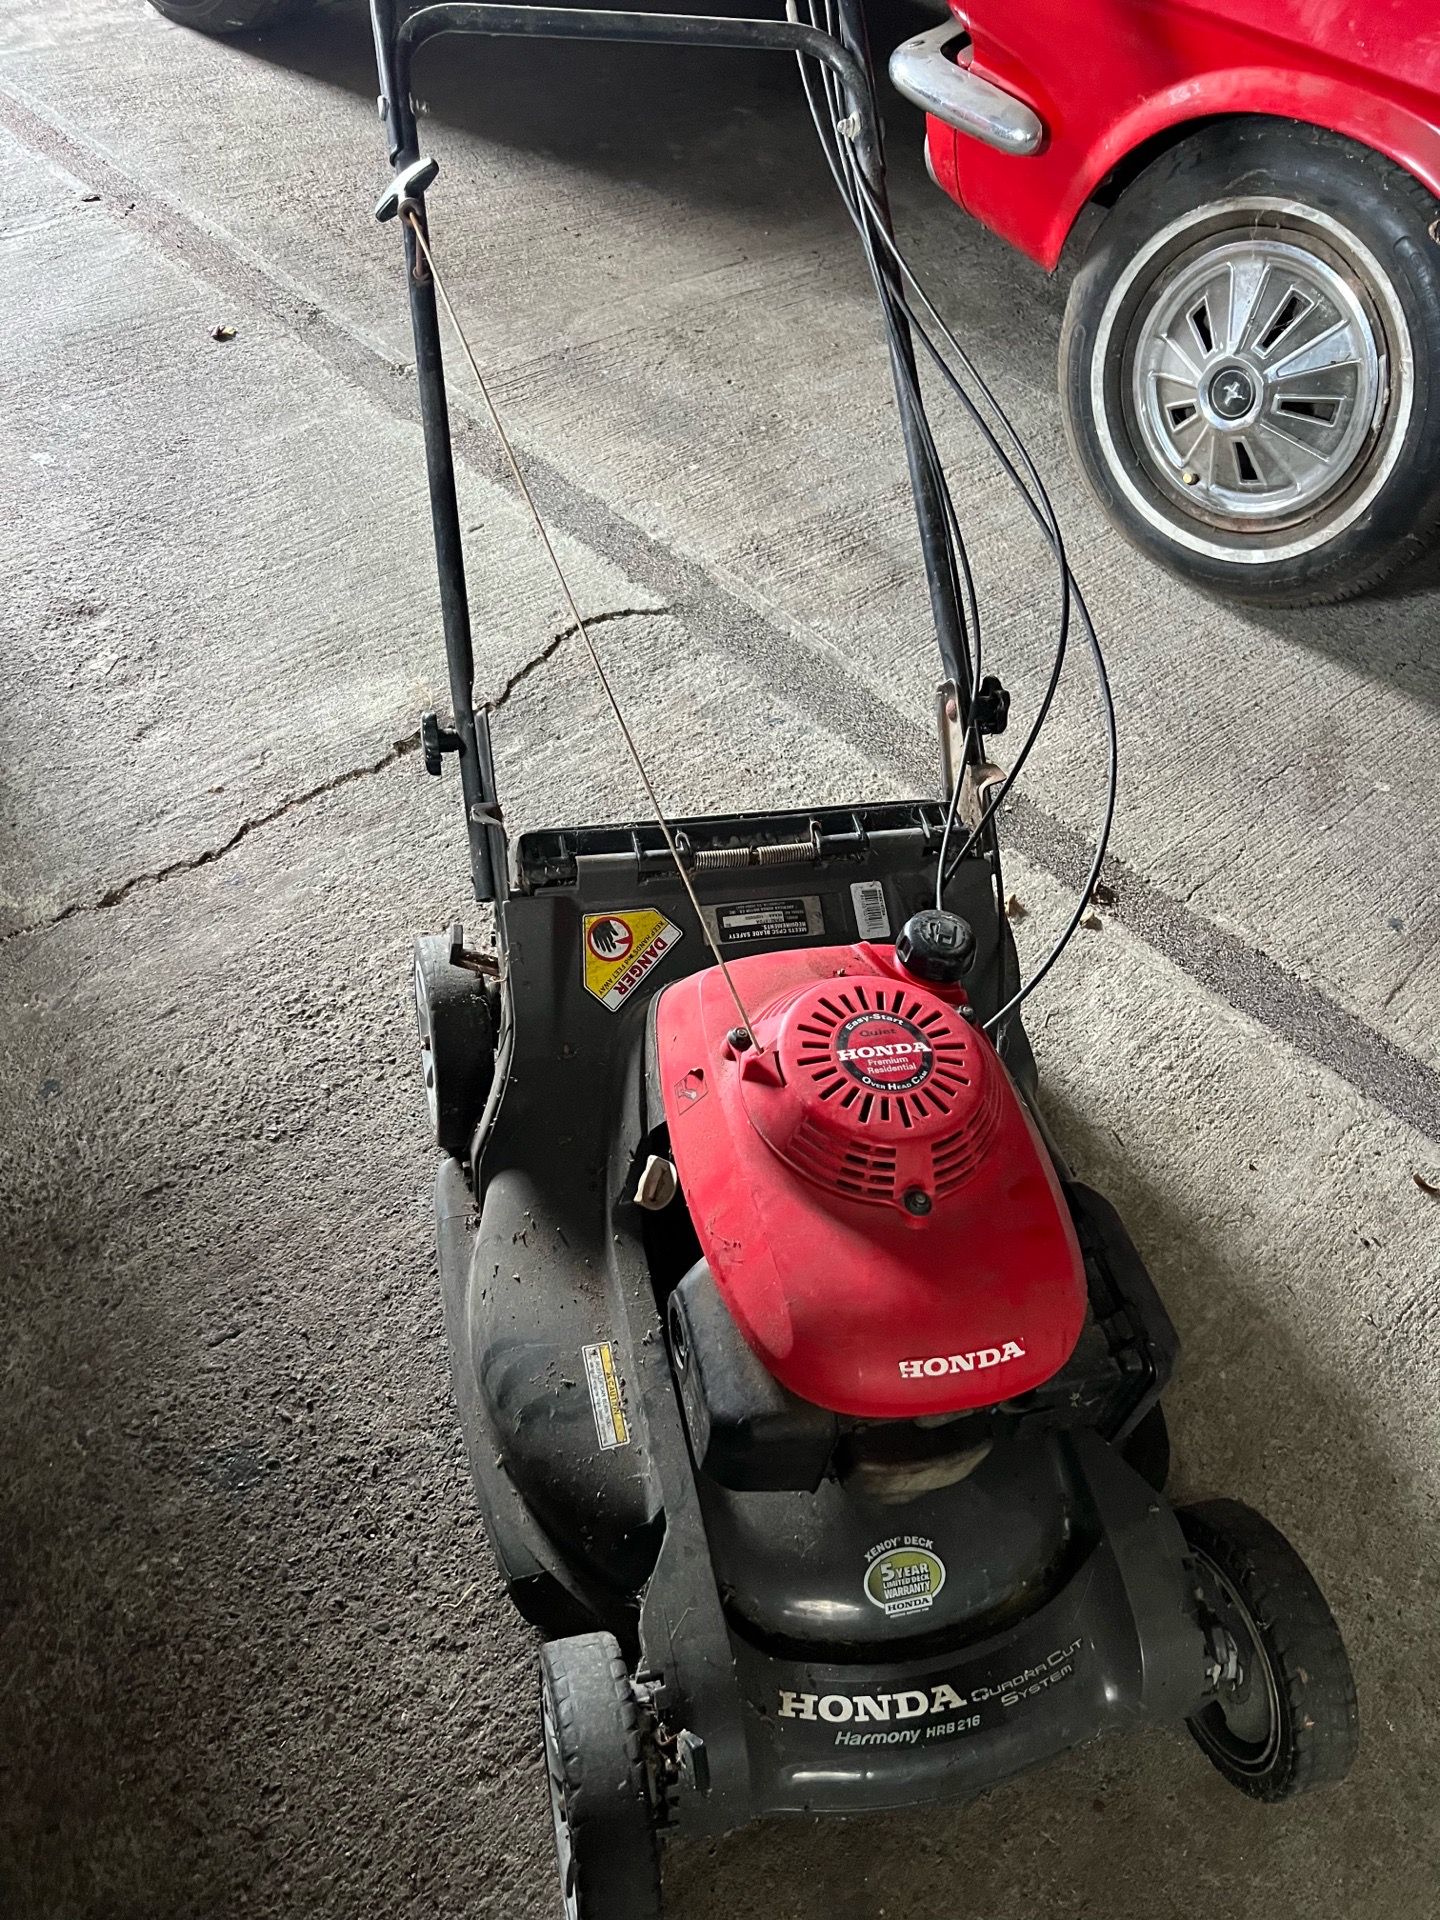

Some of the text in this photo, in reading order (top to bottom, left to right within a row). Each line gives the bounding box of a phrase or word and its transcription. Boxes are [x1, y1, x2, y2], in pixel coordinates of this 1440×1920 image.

[651, 920, 665, 937] KEEP
[728, 931, 751, 939] SAFETY
[633, 934, 652, 955] HANDS
[612, 964, 627, 978] FEET
[613, 936, 668, 995] DANGER
[598, 978, 614, 995] AWAY
[845, 1013, 904, 1031] Easy-Start
[860, 1028, 896, 1037] Quiet
[836, 1041, 932, 1062] HONDA
[867, 1056, 909, 1066] Premium
[867, 1062, 917, 1075] Residential
[898, 1341, 1026, 1378] HONDA
[903, 1535, 934, 1549] DECK
[880, 1562, 929, 1581] 5 YEAR
[882, 1574, 930, 1590] LIMITED DECK
[883, 1580, 931, 1600] WARRANTY
[887, 1598, 930, 1611] HONDA
[777, 1638, 1082, 1724] HONDA QUADRA CUT
[1001, 1664, 1073, 1707] SYSTEM
[834, 1714, 981, 1746] Harmony HRB 216
